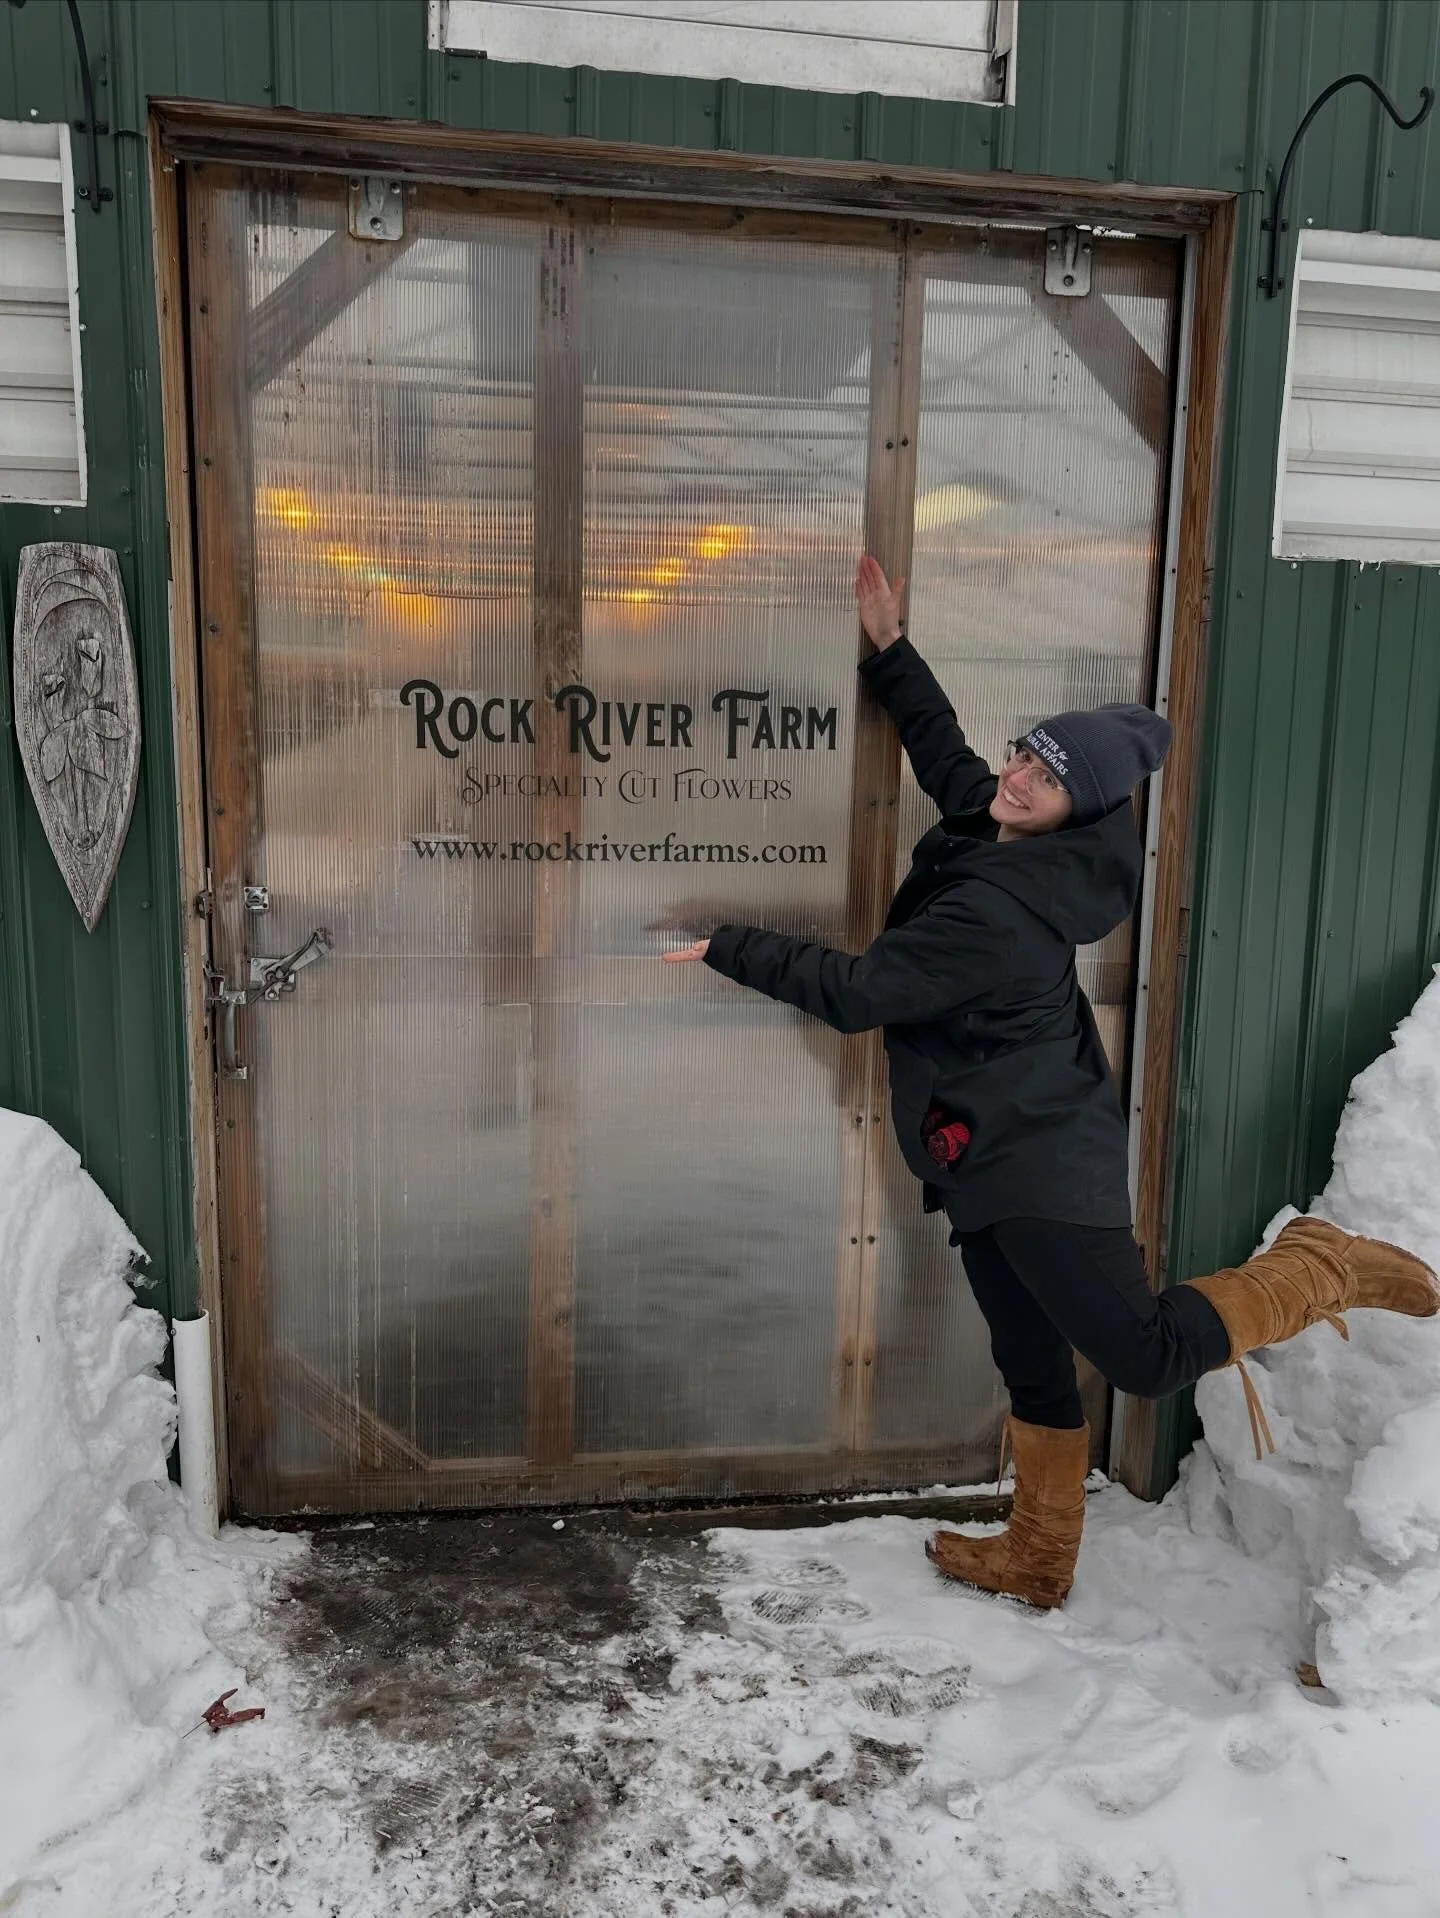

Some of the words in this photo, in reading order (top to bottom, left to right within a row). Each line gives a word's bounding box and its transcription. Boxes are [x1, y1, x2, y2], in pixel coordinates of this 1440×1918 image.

[399, 679, 536, 759] ROCK
[555, 684, 694, 763] RIVER
[711, 688, 838, 760] FARM
[1035, 728, 1060, 753] CENTER
[1039, 747, 1068, 775] AFFAIRS
[461, 766, 608, 805] SPECIALTY
[618, 769, 661, 805] CUT
[673, 768, 792, 802] FLOWERS
[412, 832, 828, 865] www.rockriverfarms.com
